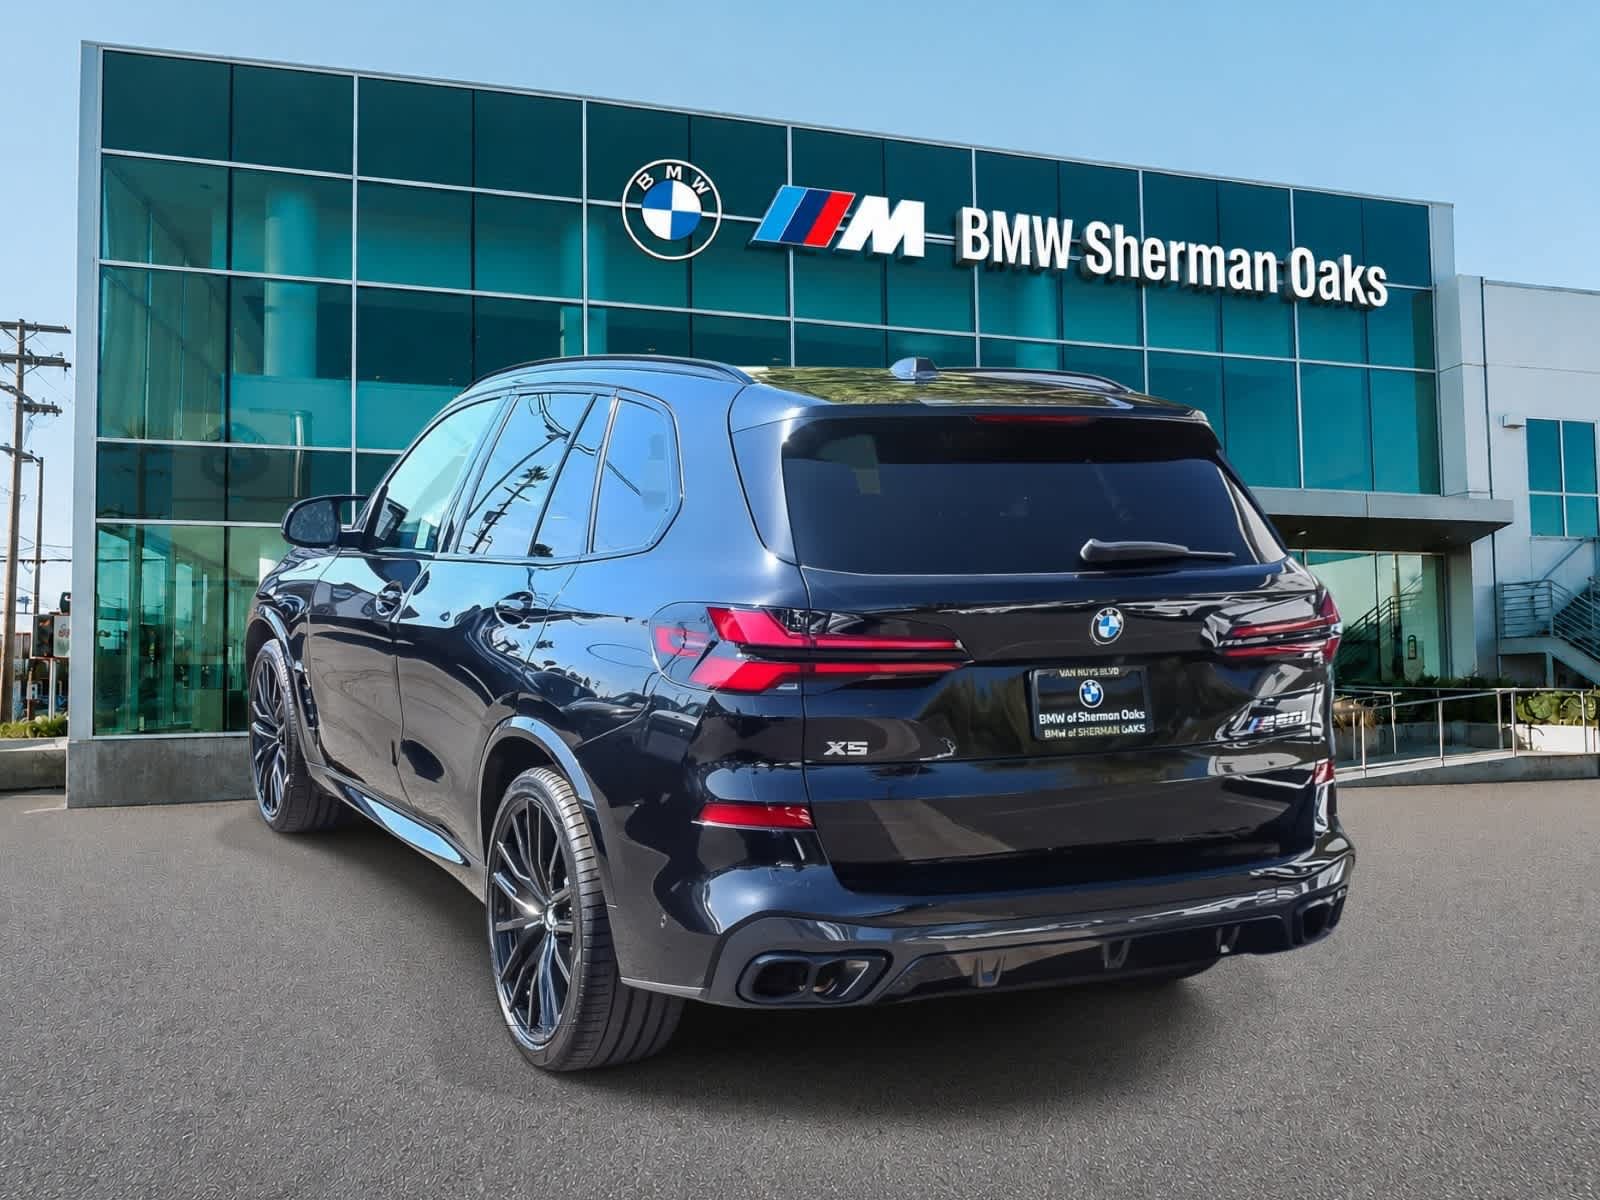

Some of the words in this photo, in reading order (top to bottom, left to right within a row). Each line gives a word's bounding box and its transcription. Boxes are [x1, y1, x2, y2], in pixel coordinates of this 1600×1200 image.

[636, 165, 711, 195] BMW
[834, 195, 925, 258] M
[959, 206, 1073, 271] BMW
[1084, 220, 1279, 294] Sherman
[1287, 246, 1389, 308] Oaks
[1059, 669, 1076, 678] VAN
[1039, 713, 1065, 725] BMW
[1067, 713, 1077, 723] of
[1077, 711, 1120, 723] Sherman
[1121, 709, 1146, 721] Oaks
[1068, 728, 1077, 737] of
[1077, 726, 1120, 737] SHERMAN
[823, 741, 869, 756] X5
